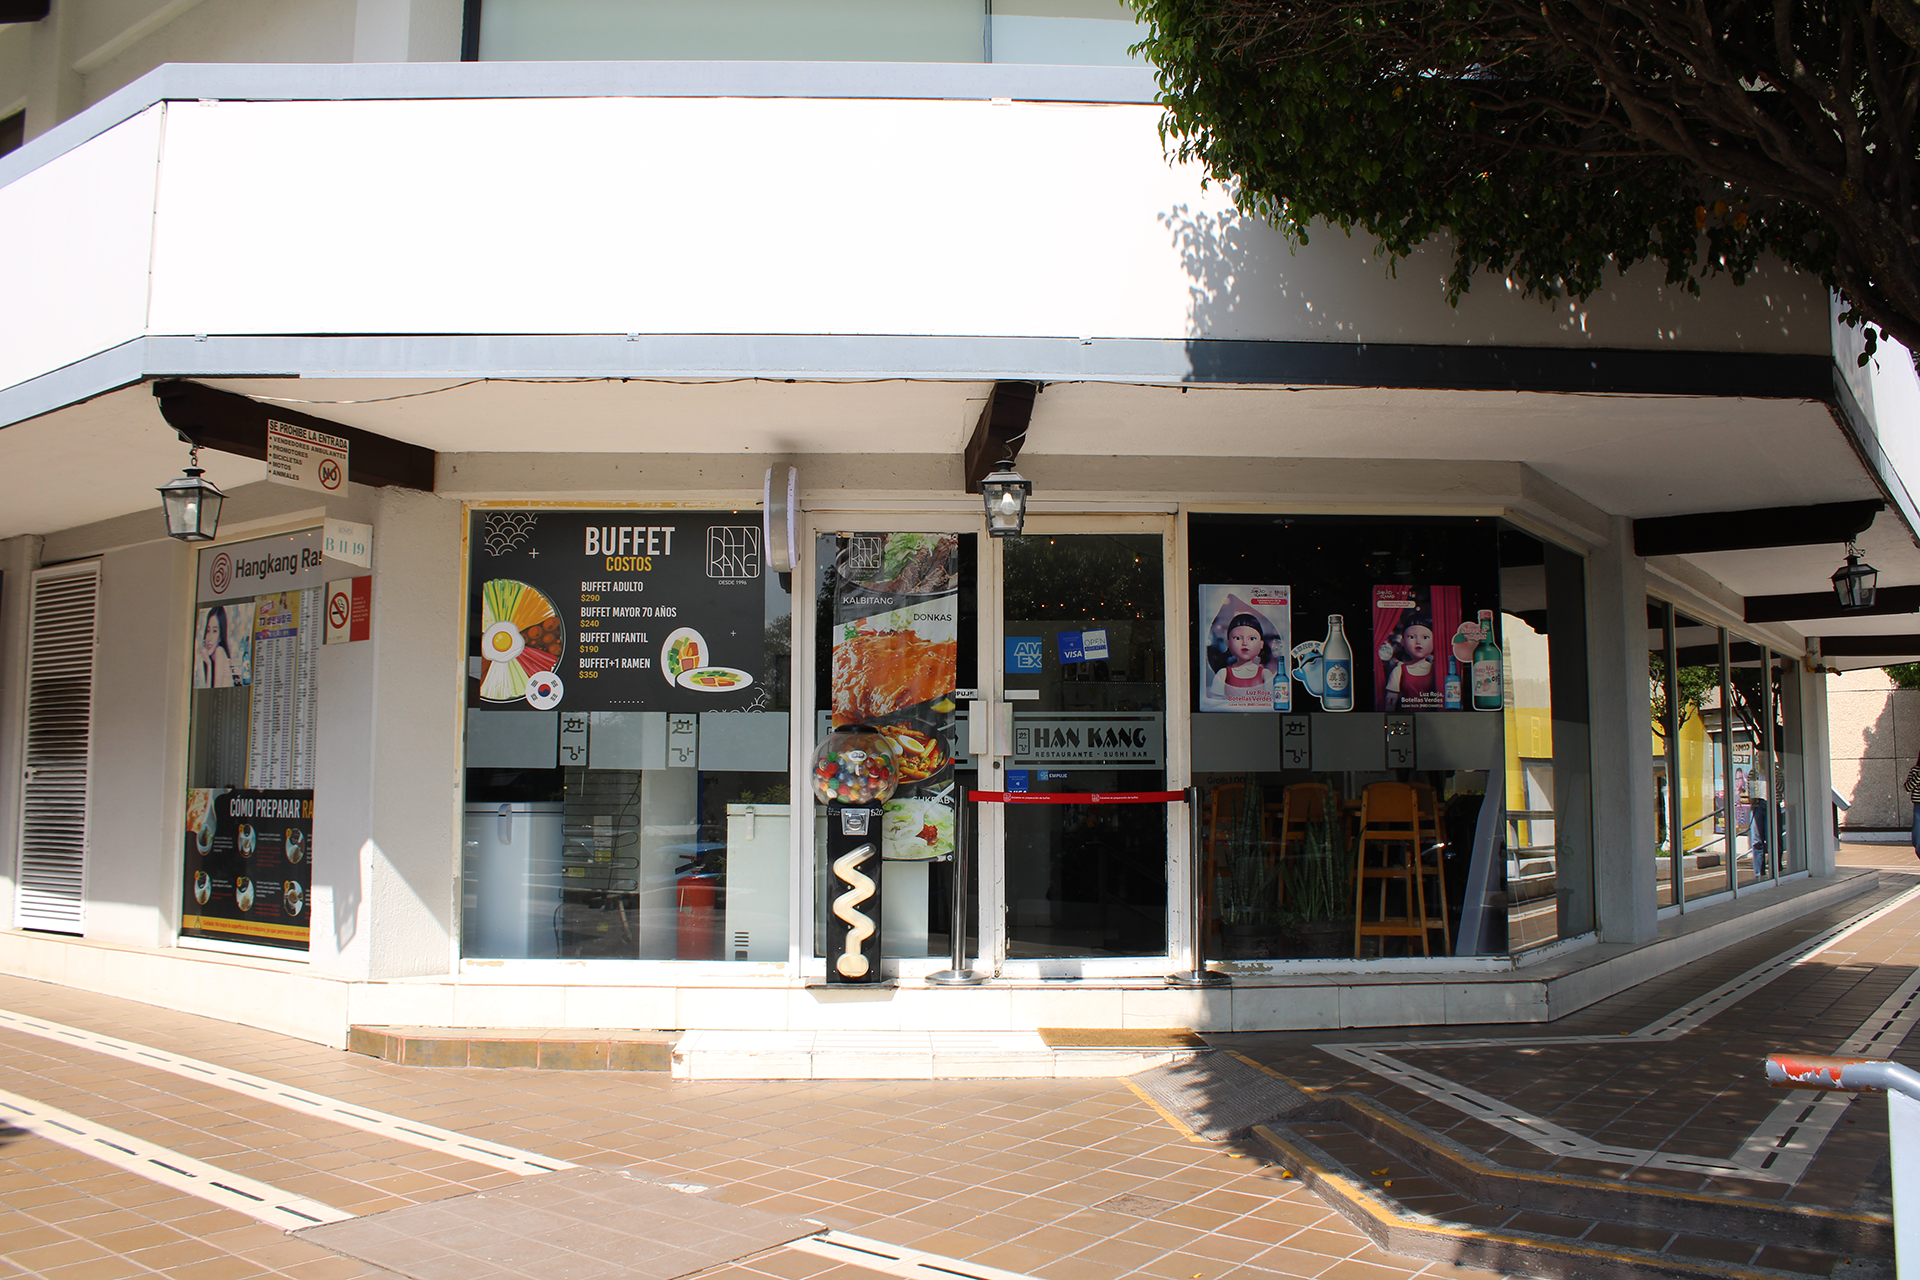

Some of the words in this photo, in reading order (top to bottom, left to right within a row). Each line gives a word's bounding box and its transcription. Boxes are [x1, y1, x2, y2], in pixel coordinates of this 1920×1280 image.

[269, 420, 278, 431] SE
[280, 423, 307, 438] PROHIBE
[309, 431, 317, 442] LA
[319, 433, 348, 449] ENTRADA
[273, 436, 310, 450] VENDEDORES
[311, 446, 346, 460] AMBULANTES
[273, 445, 308, 458] PROMOTORES
[273, 453, 302, 466] BICICLETAS
[272, 462, 291, 471] MOTOS
[273, 470, 300, 480] ANIMALES
[323, 467, 338, 481] NO
[325, 537, 334, 551] B
[584, 526, 676, 556] BUFFET
[235, 553, 298, 580] Hangkang
[606, 556, 652, 572] COSTOS
[581, 581, 612, 592] BUFFET
[612, 581, 644, 592] ADULTO
[580, 594, 600, 602] $290
[843, 596, 894, 605] KALBITANG
[580, 606, 611, 618] BUFFET
[612, 606, 641, 618] MAYOR
[642, 606, 653, 618] 70
[654, 604, 677, 618] AÑOS
[580, 619, 600, 628] $240
[914, 613, 952, 622] DONKAS
[580, 632, 610, 643] BUFFET
[612, 632, 648, 643] INFANTIL
[579, 645, 599, 654] $190
[1064, 650, 1083, 658] VISA
[579, 658, 620, 668] BUFFET+1
[621, 658, 651, 668] RAMEN
[578, 670, 598, 679] $350
[1034, 727, 1081, 749] HAN
[1087, 727, 1147, 749] KANG
[230, 795, 254, 818] CÓMO
[255, 798, 300, 818] PREPARAR
